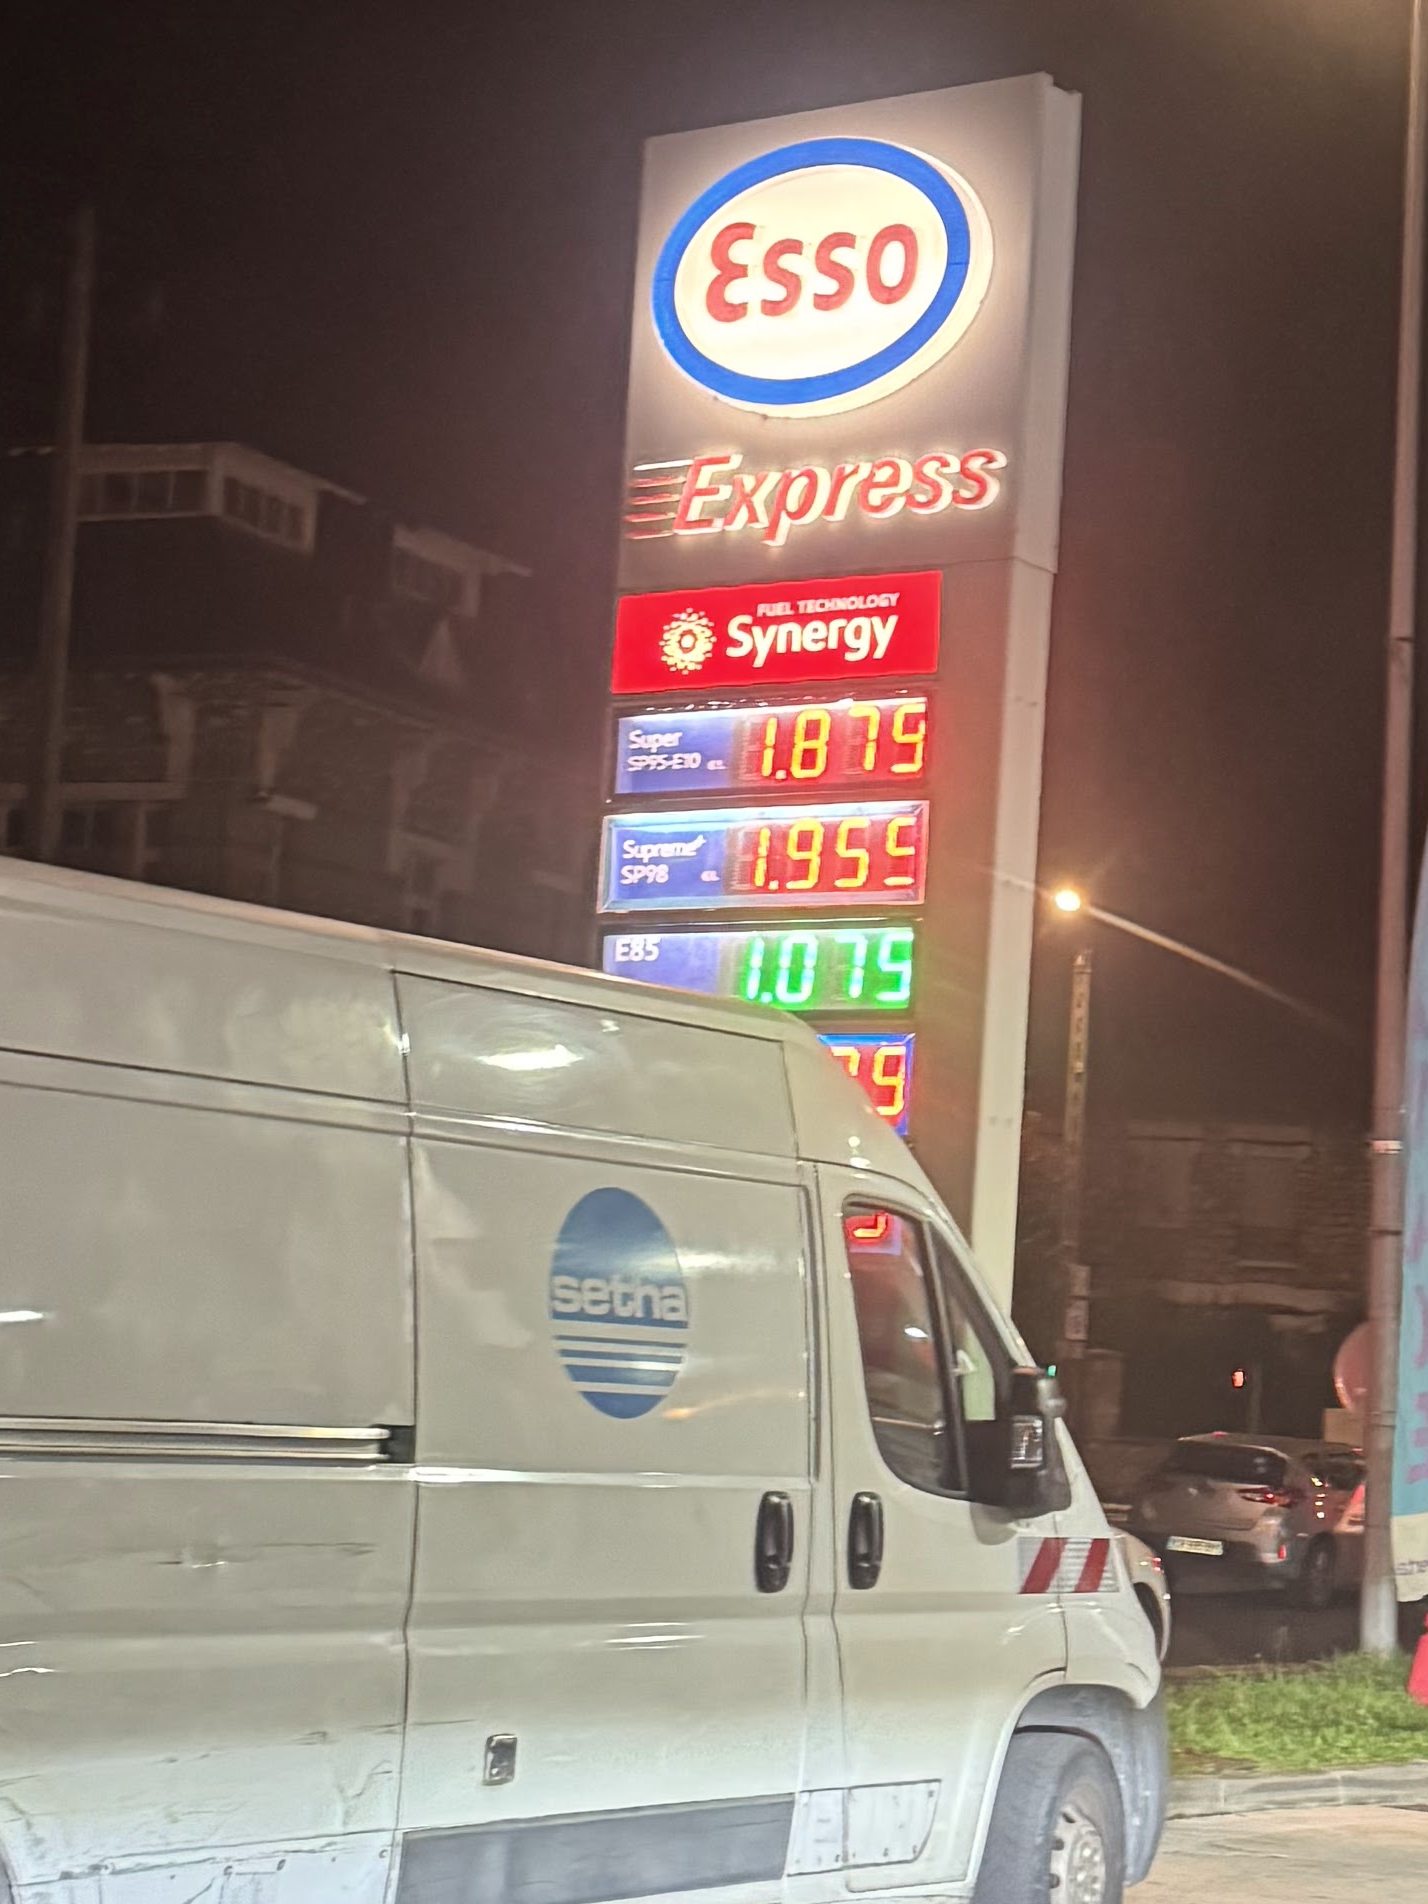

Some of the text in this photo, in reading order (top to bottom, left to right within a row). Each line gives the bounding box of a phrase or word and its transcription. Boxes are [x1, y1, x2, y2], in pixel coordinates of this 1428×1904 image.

[673, 448, 1008, 546] Express
[756, 592, 900, 618] FUEL TECHNOLOGY
[725, 614, 899, 668] Synergy
[628, 729, 683, 753] Super
[626, 752, 702, 772] SP95-E10
[619, 864, 669, 885] SP98
[614, 936, 662, 962] E85
